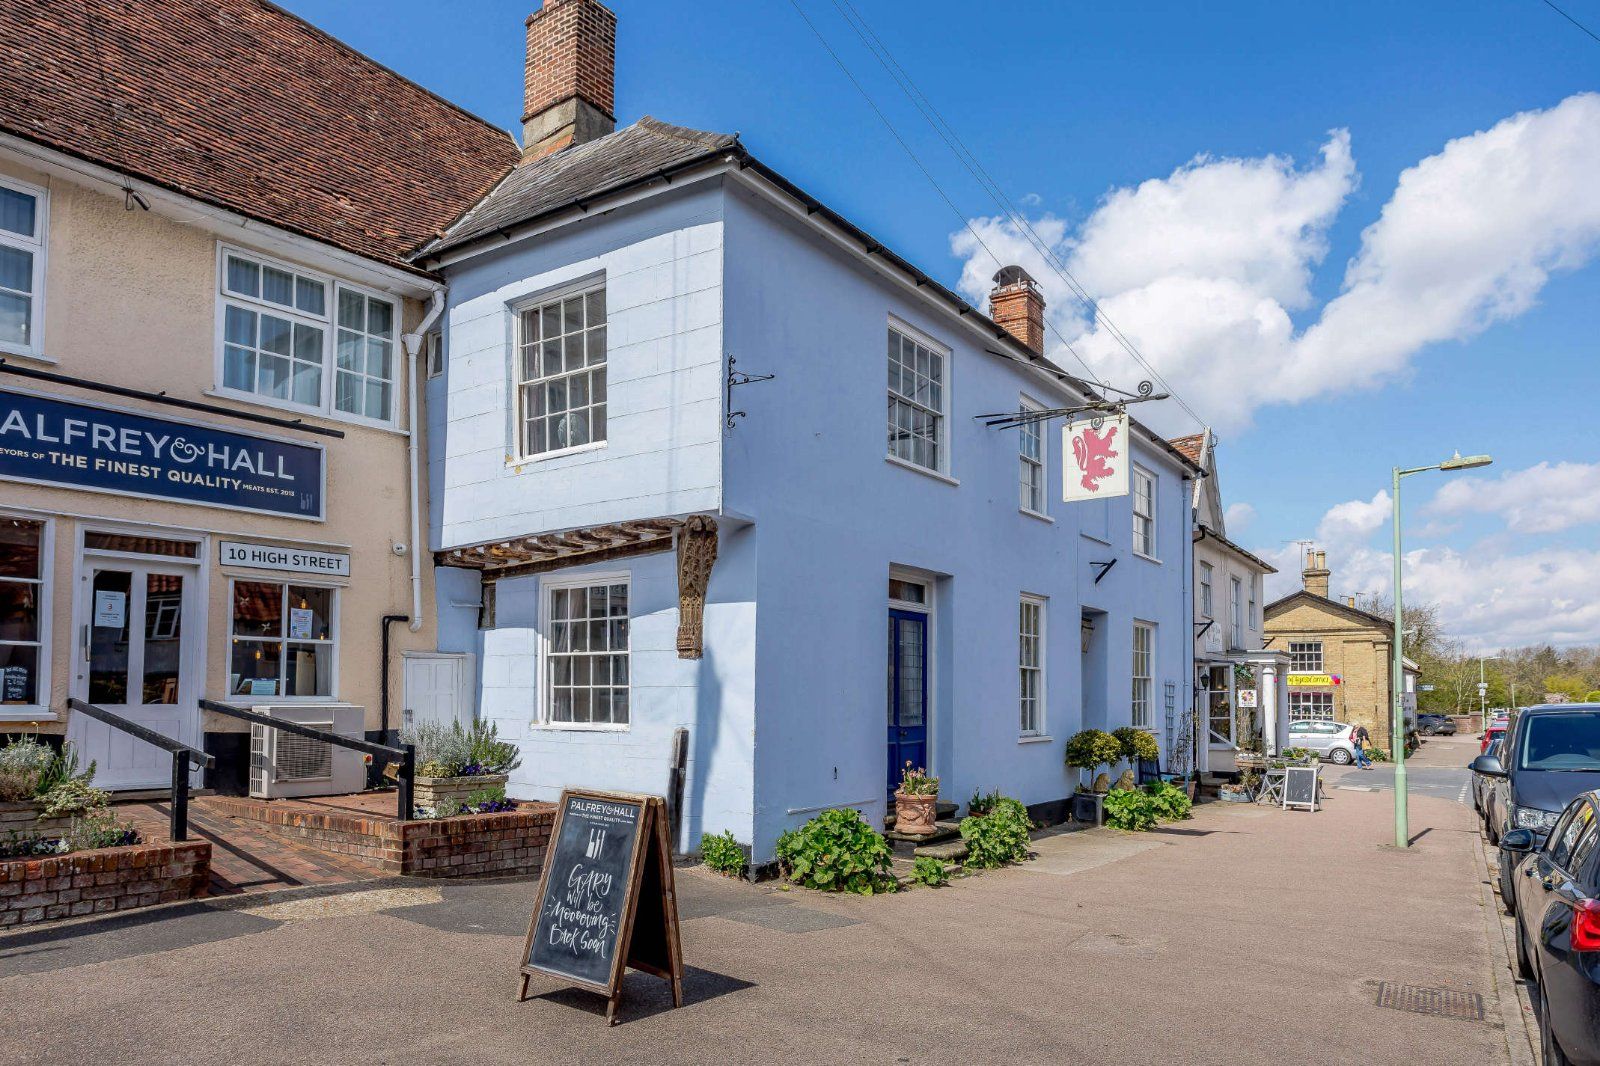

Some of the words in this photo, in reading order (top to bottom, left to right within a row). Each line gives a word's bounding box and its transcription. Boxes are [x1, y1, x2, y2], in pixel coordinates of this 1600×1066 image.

[31, 452, 45, 460] OF
[49, 451, 88, 469] THE
[95, 458, 161, 479] FINEST
[167, 469, 241, 490] QUALITY
[242, 483, 265, 493] MEATS
[228, 548, 247, 561] 10
[251, 550, 288, 565] HIGH
[292, 554, 342, 570] STREET
[586, 892, 603, 913] be
